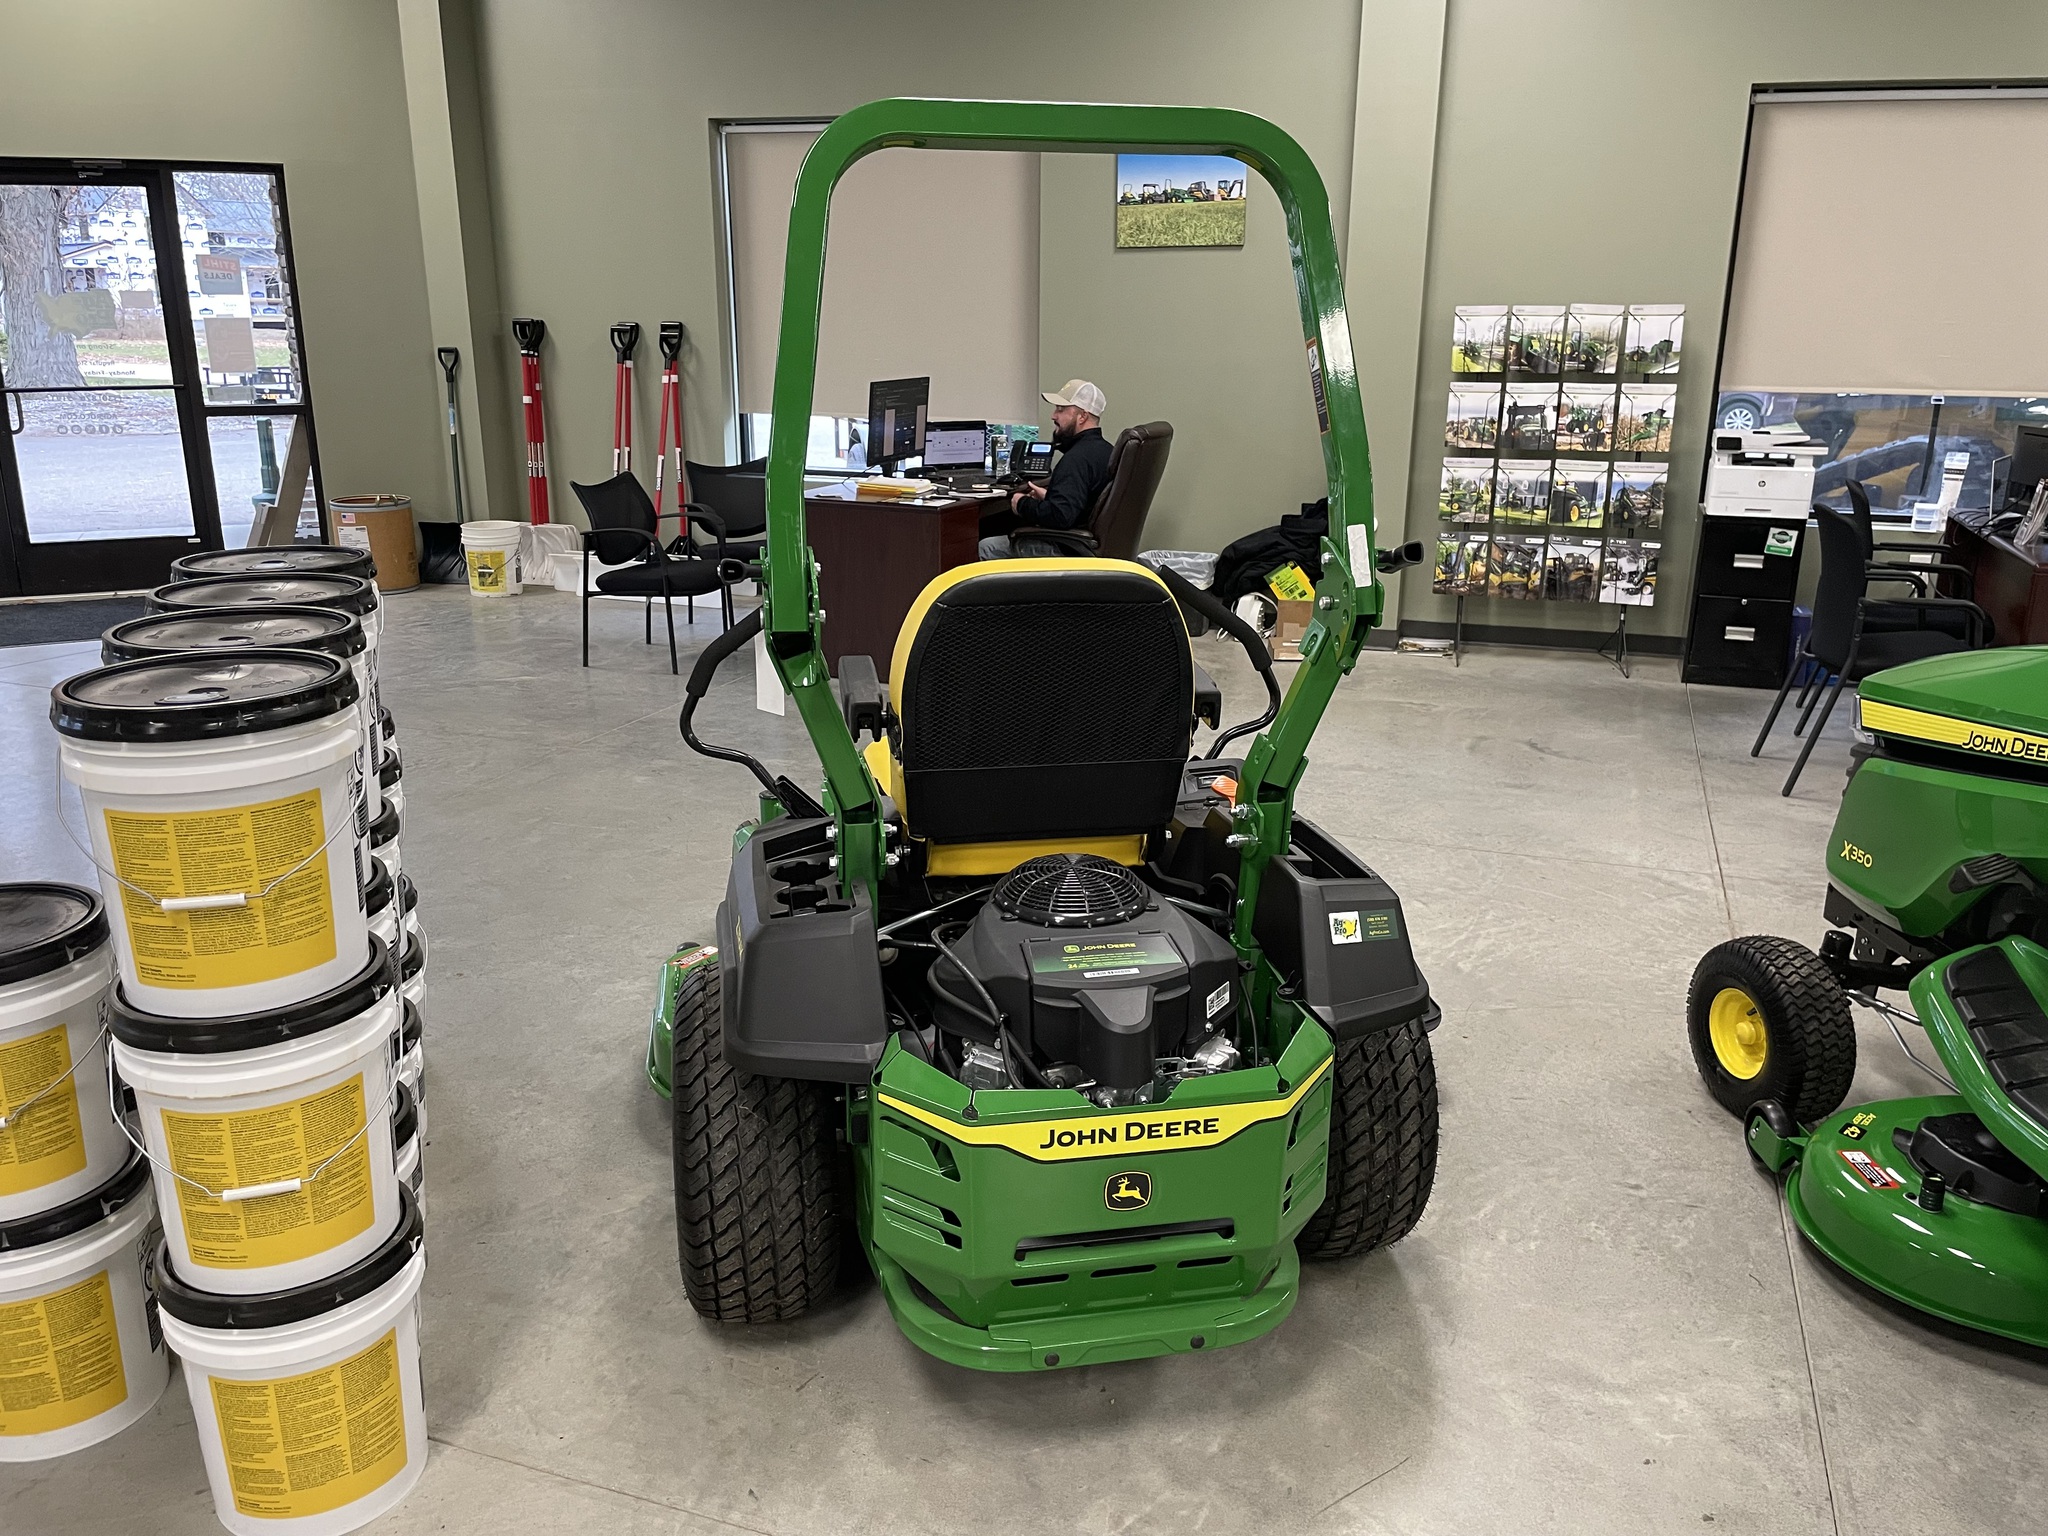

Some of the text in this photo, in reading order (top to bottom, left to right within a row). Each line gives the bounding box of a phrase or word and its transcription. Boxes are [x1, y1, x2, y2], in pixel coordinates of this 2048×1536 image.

[1963, 731, 2048, 758] JOHN DEE
[1840, 840, 1873, 869] X350
[1334, 926, 1347, 935] Pro
[1040, 1117, 1219, 1149] JOHN DEERE
[1843, 1126, 1861, 1138] 42
